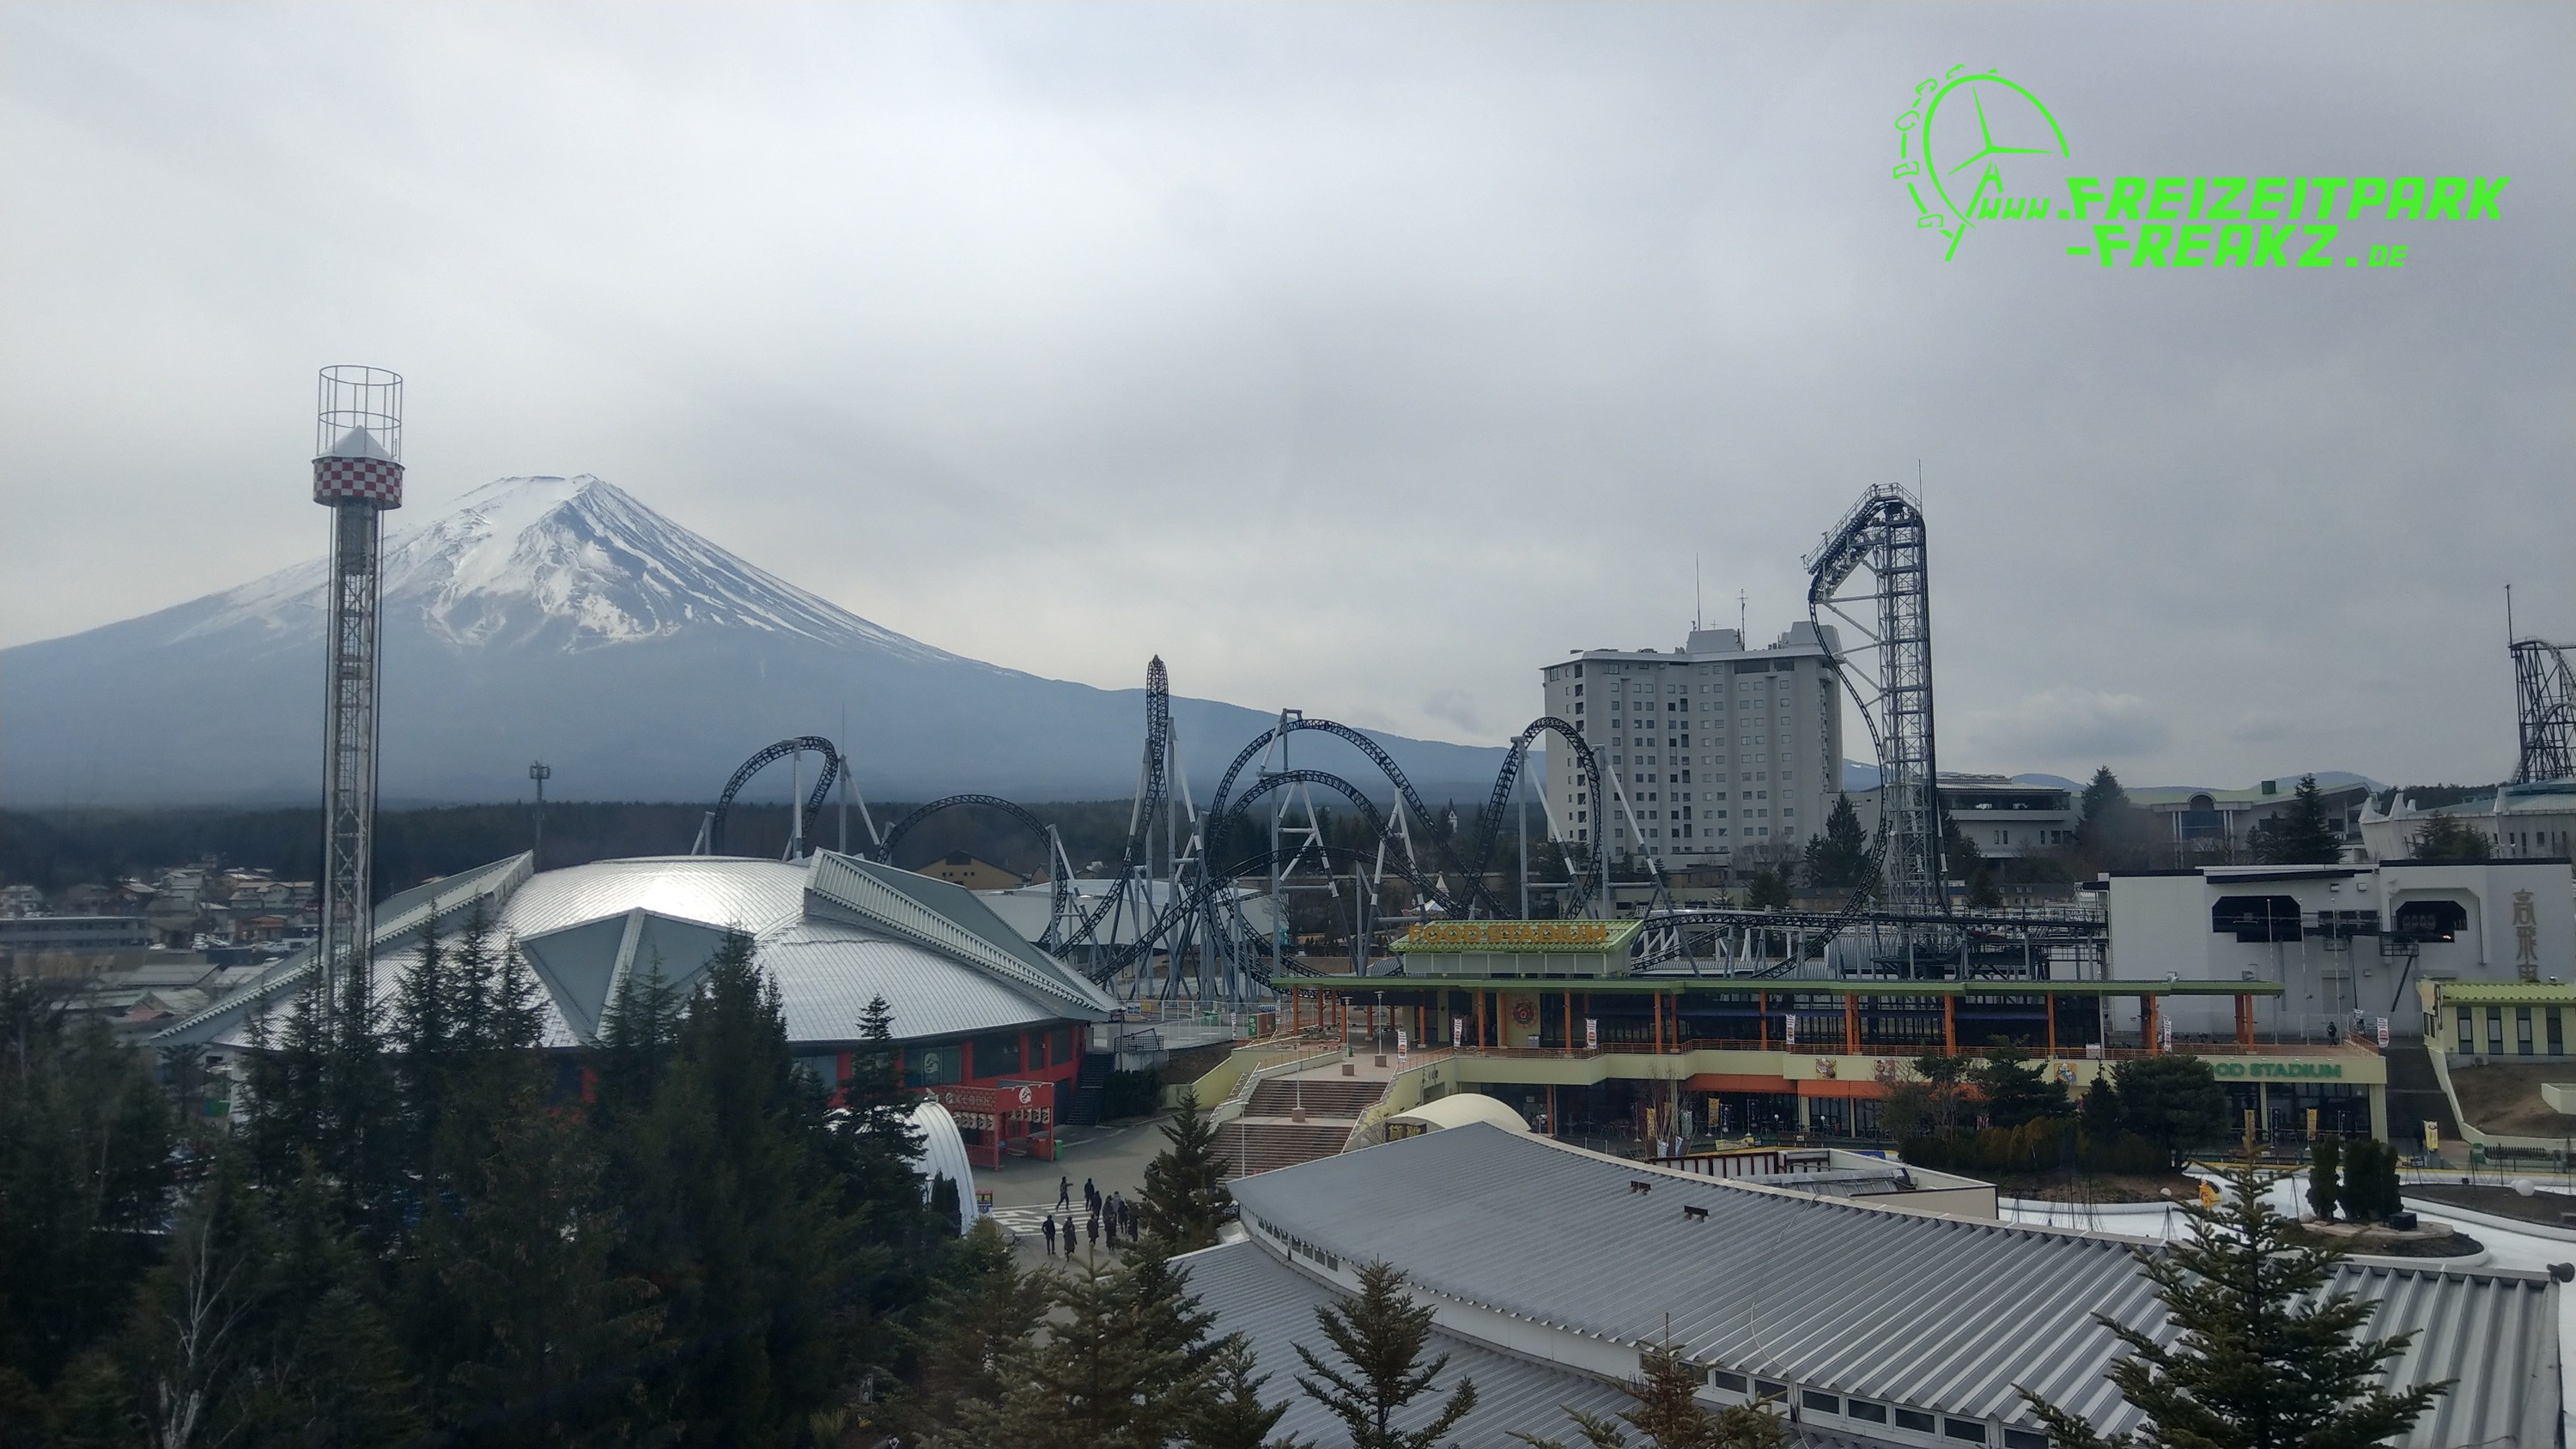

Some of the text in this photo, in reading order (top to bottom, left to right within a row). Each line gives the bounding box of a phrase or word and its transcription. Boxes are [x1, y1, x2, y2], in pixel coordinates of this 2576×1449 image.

[1407, 925, 1607, 944] FOOD STADIUM
[2250, 1063, 2342, 1078] STADIUM
